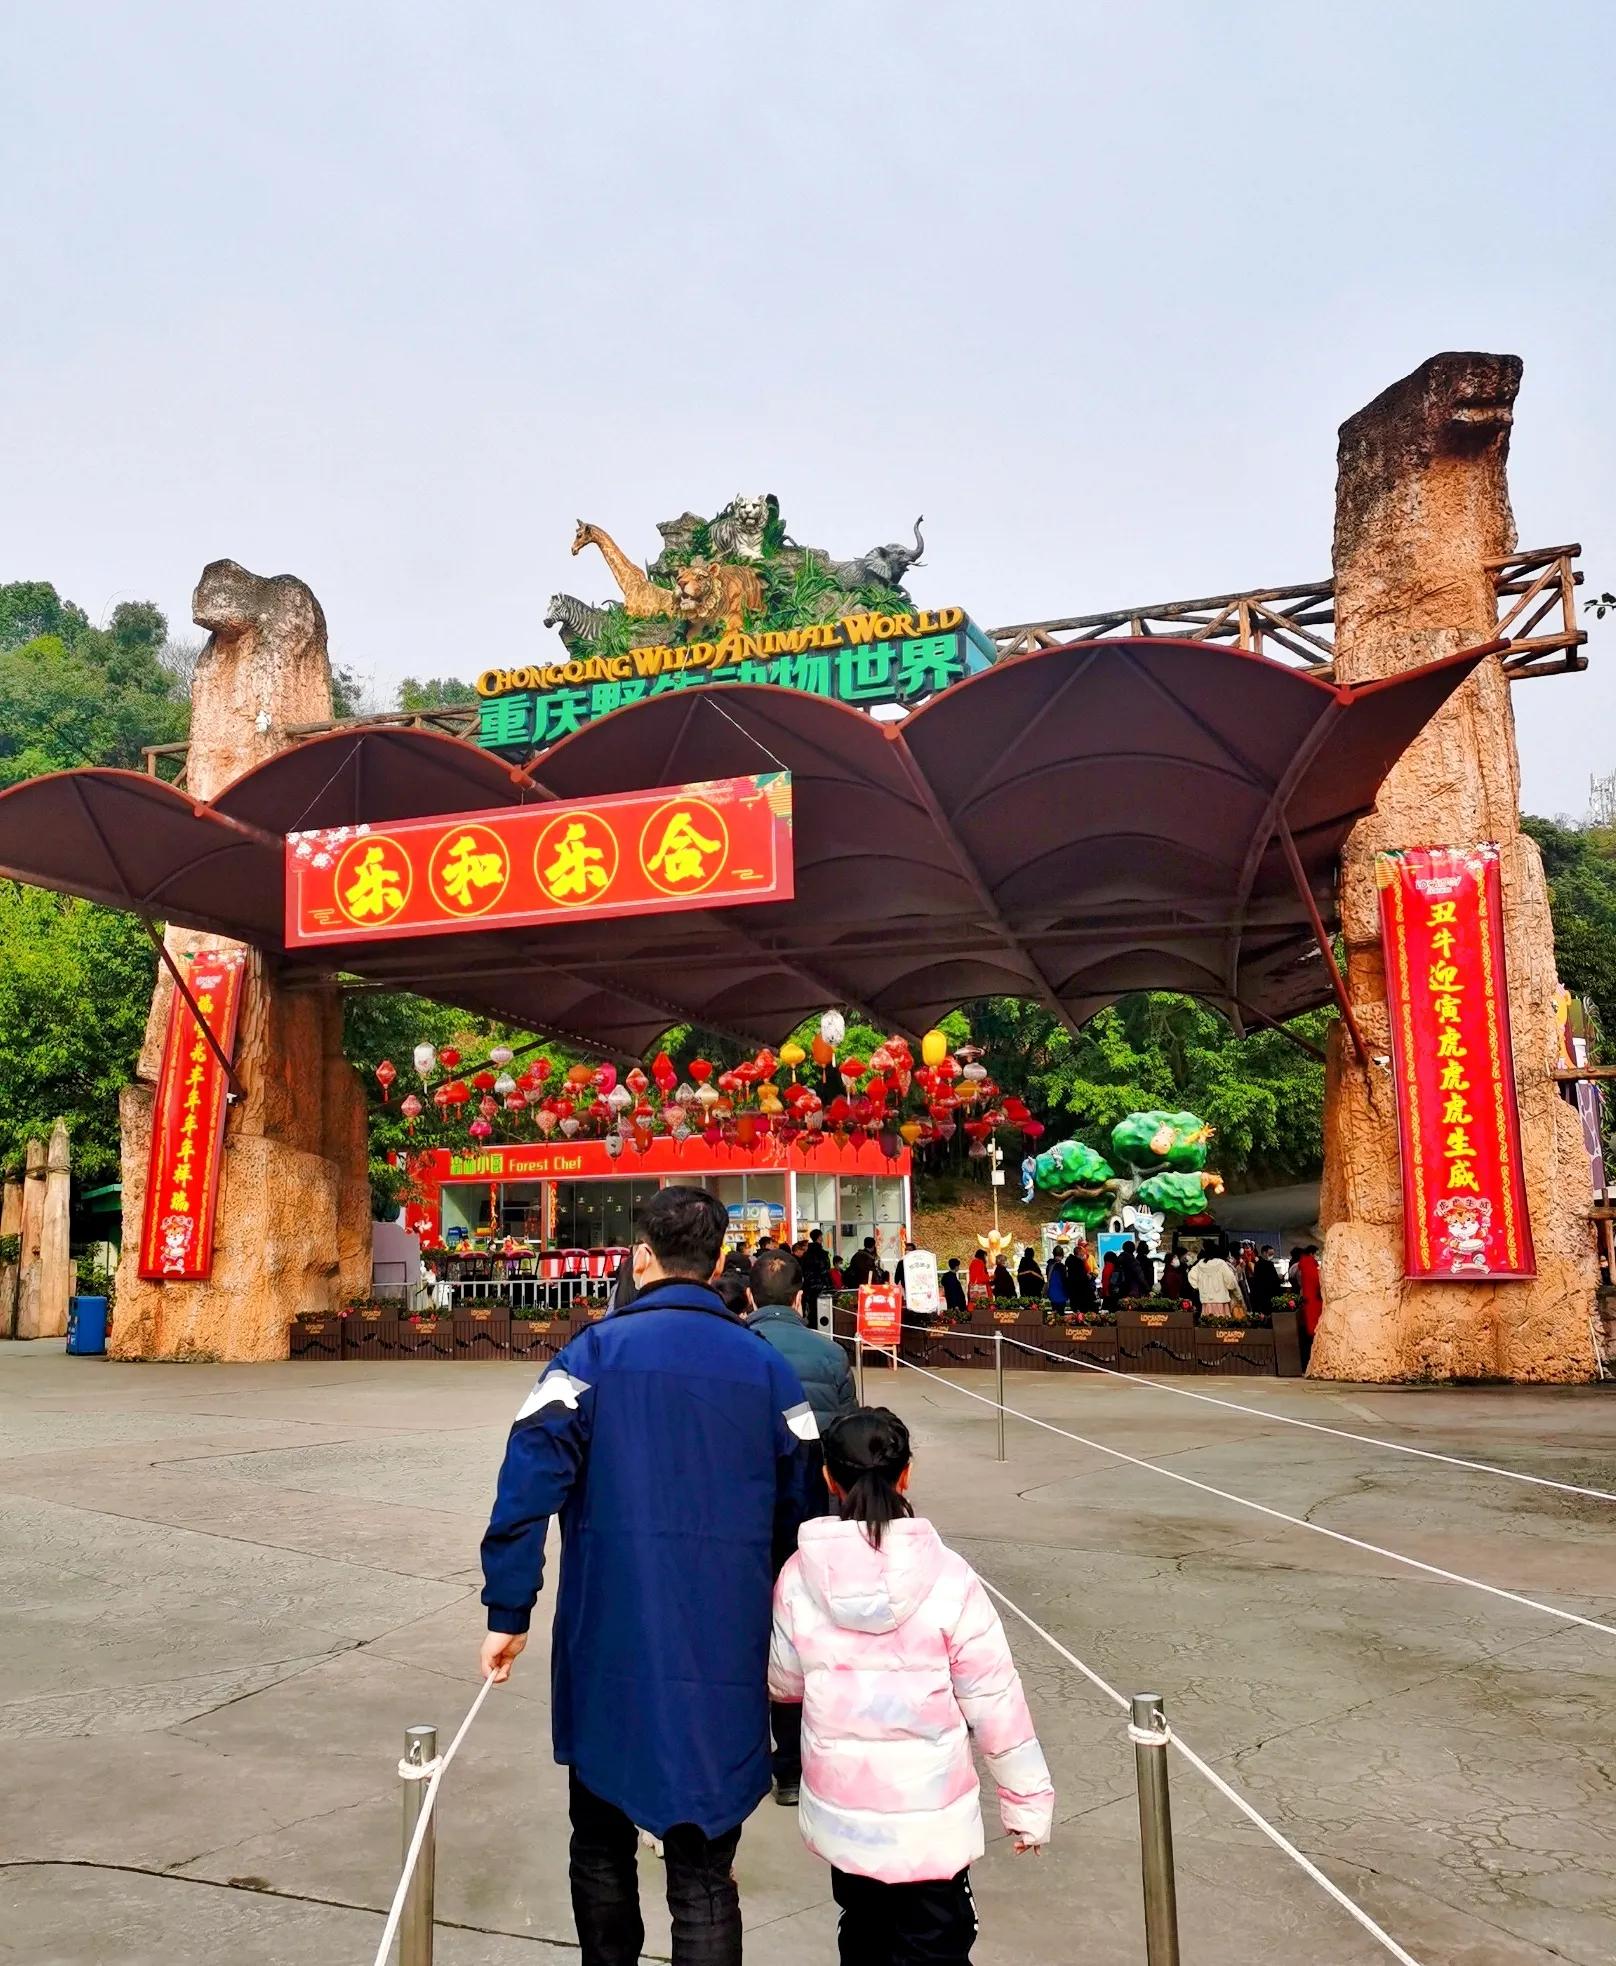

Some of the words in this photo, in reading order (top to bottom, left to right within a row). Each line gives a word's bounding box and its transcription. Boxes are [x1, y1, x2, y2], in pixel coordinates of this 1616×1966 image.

[475, 655, 633, 698] CHONGQING
[629, 641, 717, 677] WILD
[706, 623, 844, 670] ANIMAL
[841, 606, 965, 645] WORLD
[1425, 900, 1480, 1193] 丑牛迎寅虎虎虎生威
[509, 1158, 549, 1173] Forest
[554, 1155, 583, 1170] Chef
